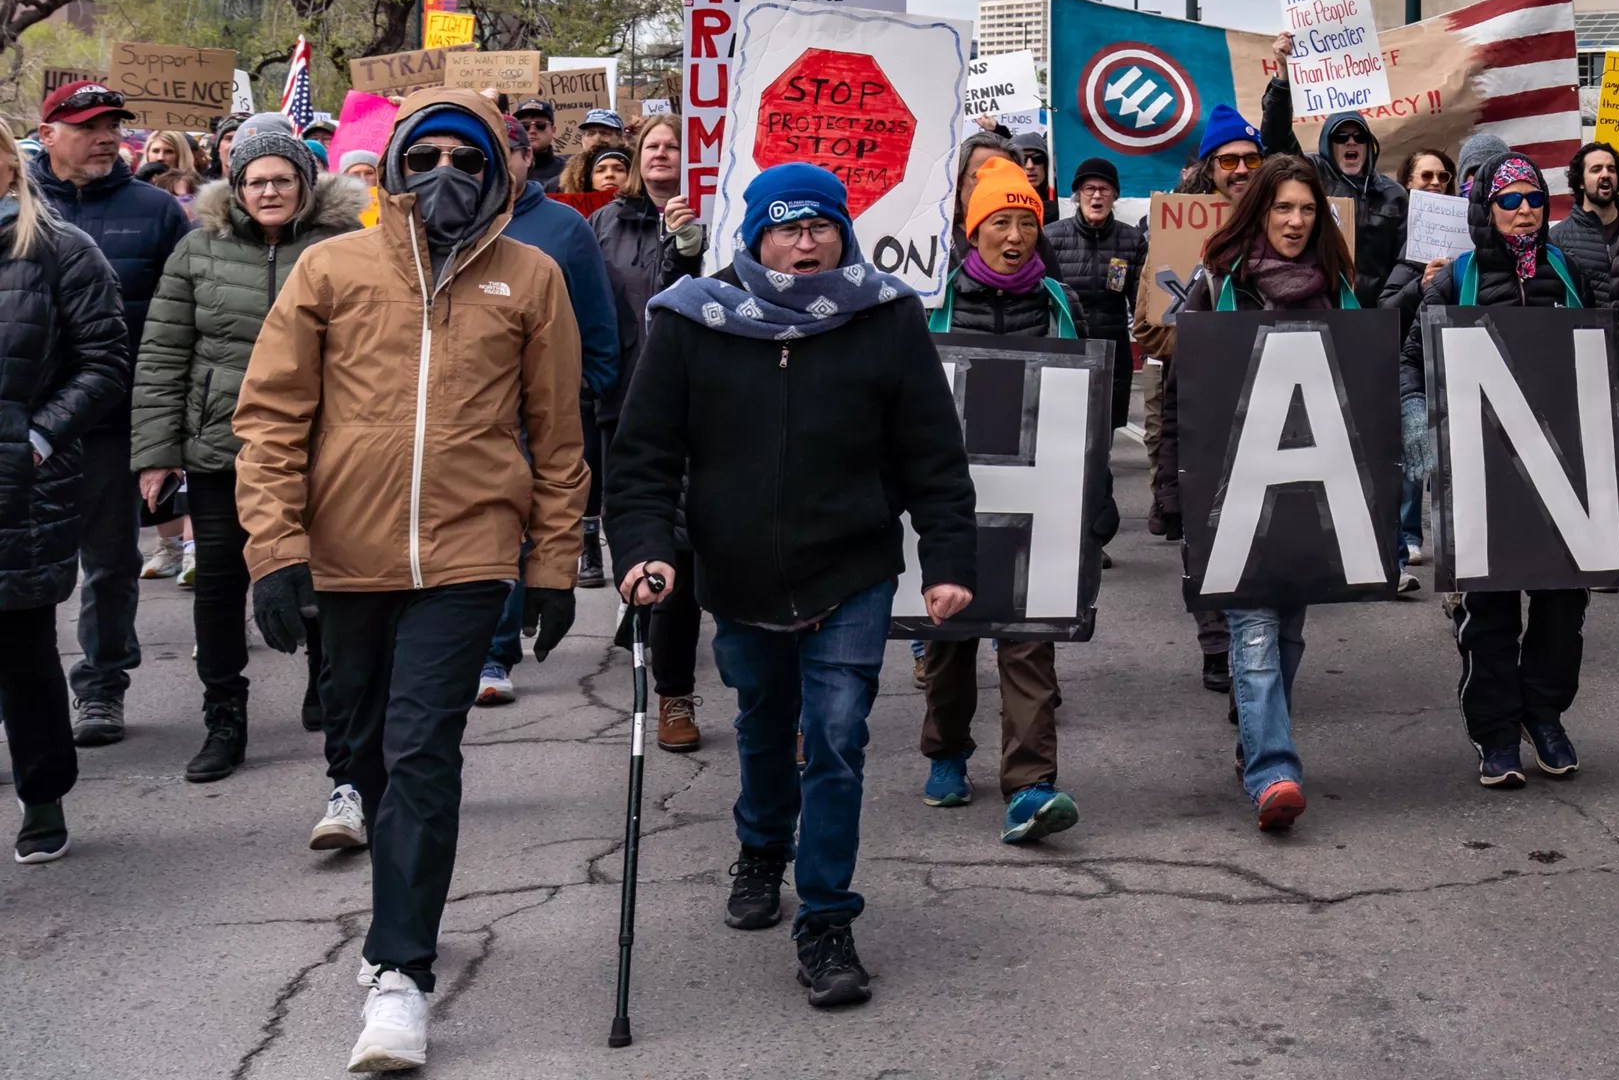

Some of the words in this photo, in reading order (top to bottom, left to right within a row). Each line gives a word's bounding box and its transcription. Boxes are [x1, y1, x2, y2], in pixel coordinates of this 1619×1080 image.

[1286, 6, 1313, 30] The
[1289, 34, 1309, 59] Is
[1309, 24, 1365, 54] Greater
[118, 44, 211, 72] Support
[452, 55, 470, 65] WE
[474, 55, 499, 64] WANT
[503, 55, 516, 65] TO
[518, 54, 531, 65] BE
[1288, 61, 1324, 85] Than
[1319, 56, 1345, 81] The
[1344, 52, 1381, 78] People
[455, 80, 475, 89] SIDE
[480, 80, 491, 89] OF
[496, 80, 533, 90] HISTORY
[459, 69, 473, 77] ON
[475, 69, 493, 77] THE
[498, 68, 524, 79] GOOD
[550, 72, 606, 95] PROTECT
[120, 72, 233, 104] SCIENCE
[784, 75, 885, 109] STOP
[1304, 88, 1323, 112] In
[1326, 85, 1371, 109] Power
[121, 110, 153, 126] OT
[768, 112, 860, 133] PROJECT
[863, 119, 908, 135] 2025
[1001, 113, 1032, 124] FUNDS
[786, 134, 879, 159] STOP
[817, 162, 888, 190] CISM
[1161, 201, 1231, 230] NOT
